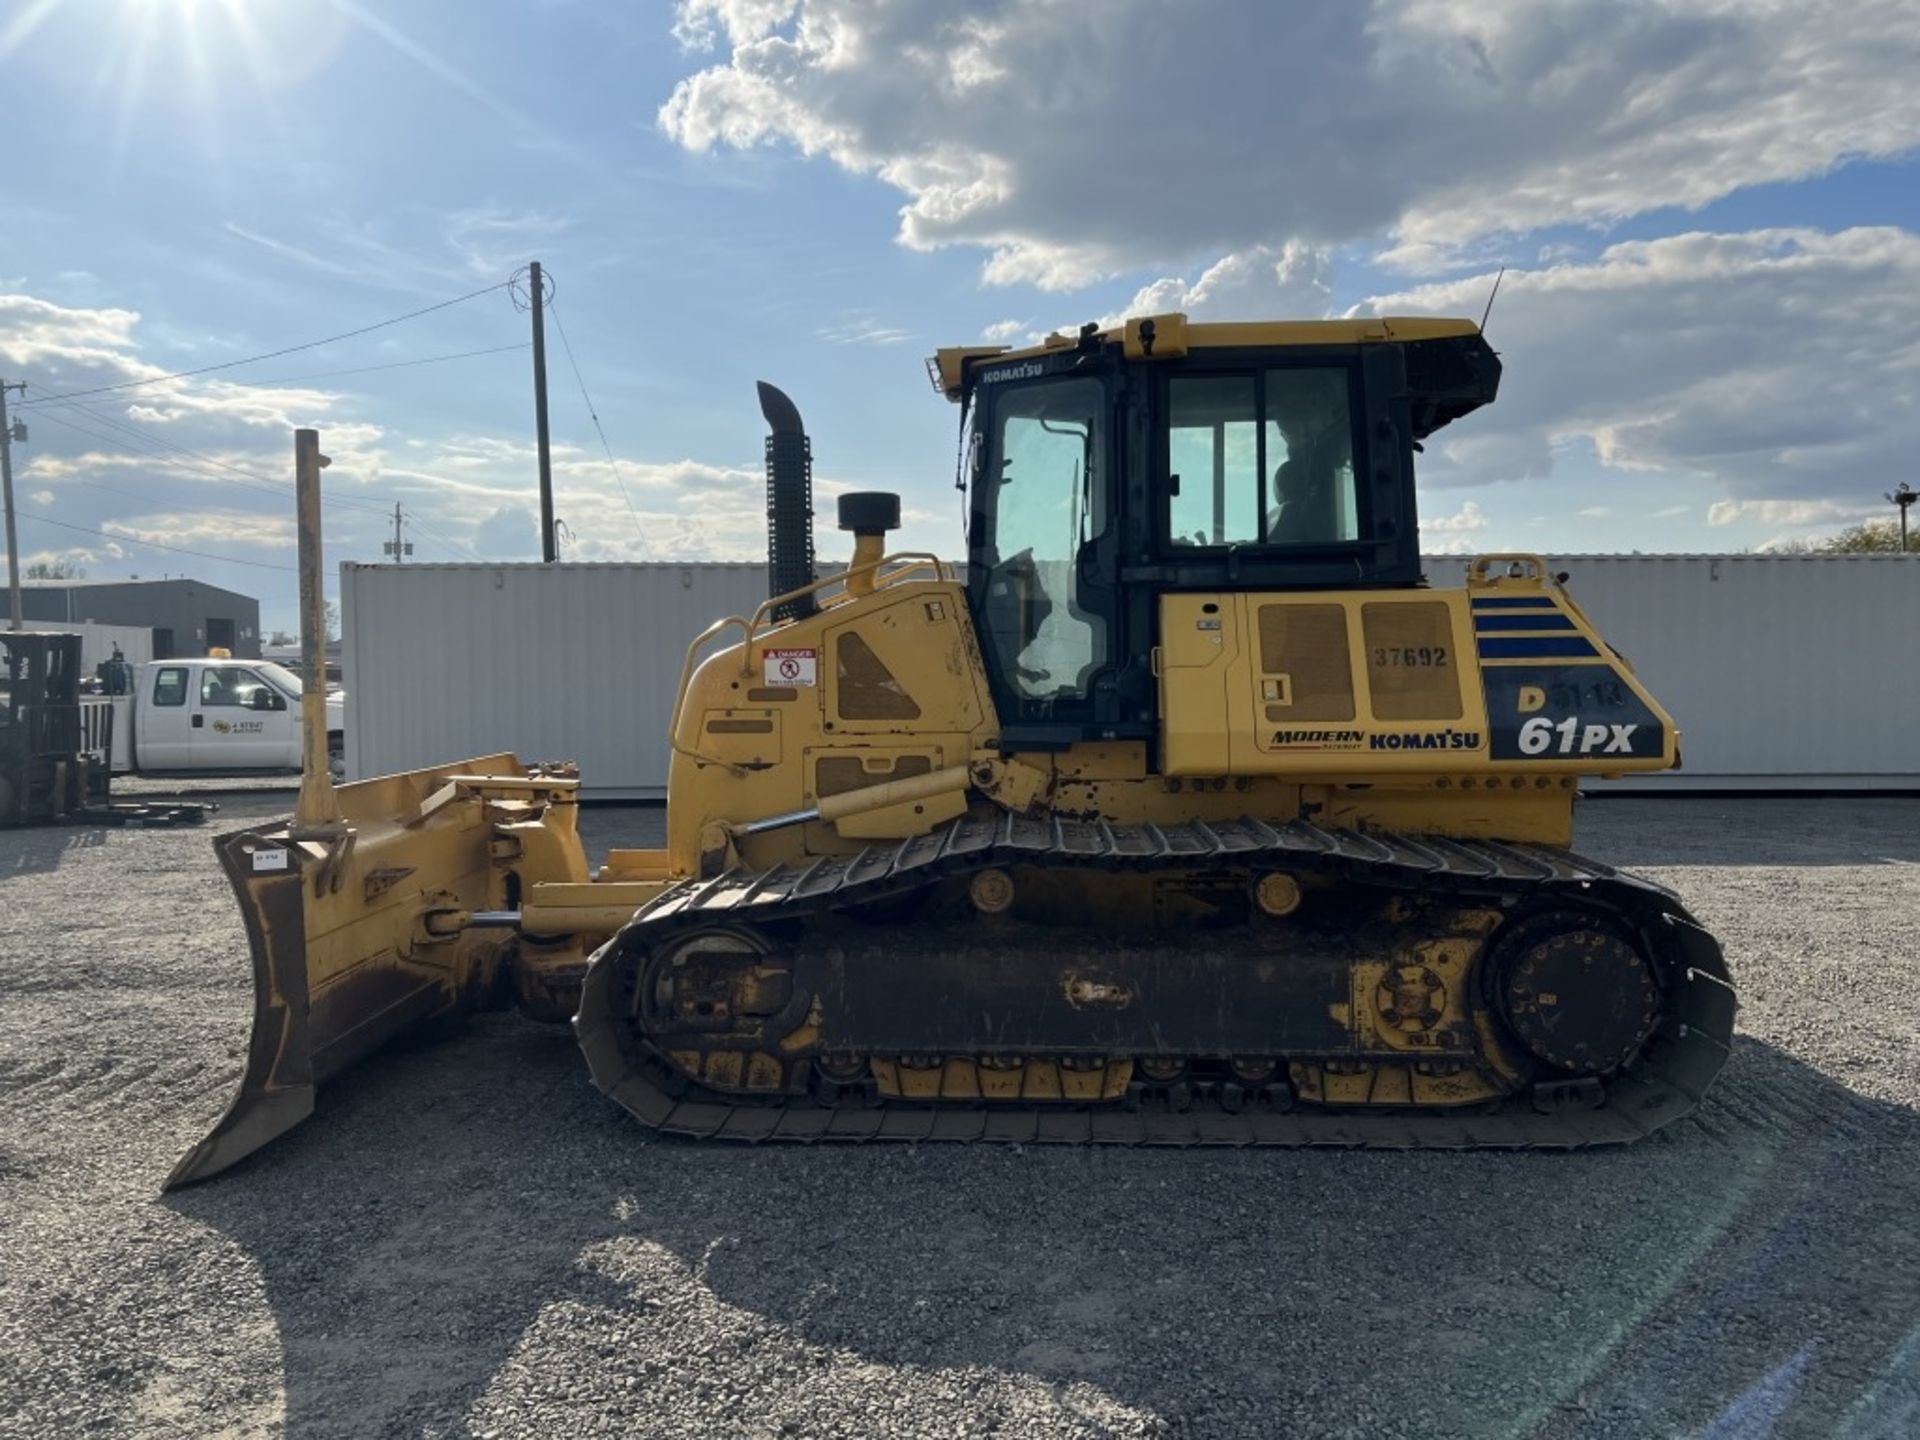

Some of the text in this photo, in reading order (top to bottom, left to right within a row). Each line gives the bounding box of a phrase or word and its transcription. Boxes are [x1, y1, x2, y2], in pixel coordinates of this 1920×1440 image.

[984, 362, 1043, 383] KOMATSU
[777, 650, 813, 658] DANGER
[1374, 648, 1447, 666] 37692
[1517, 686, 1546, 712] D
[1271, 731, 1365, 744] MODERN
[1370, 729, 1480, 750] KOMATSU
[1518, 716, 1639, 755] 61PX
